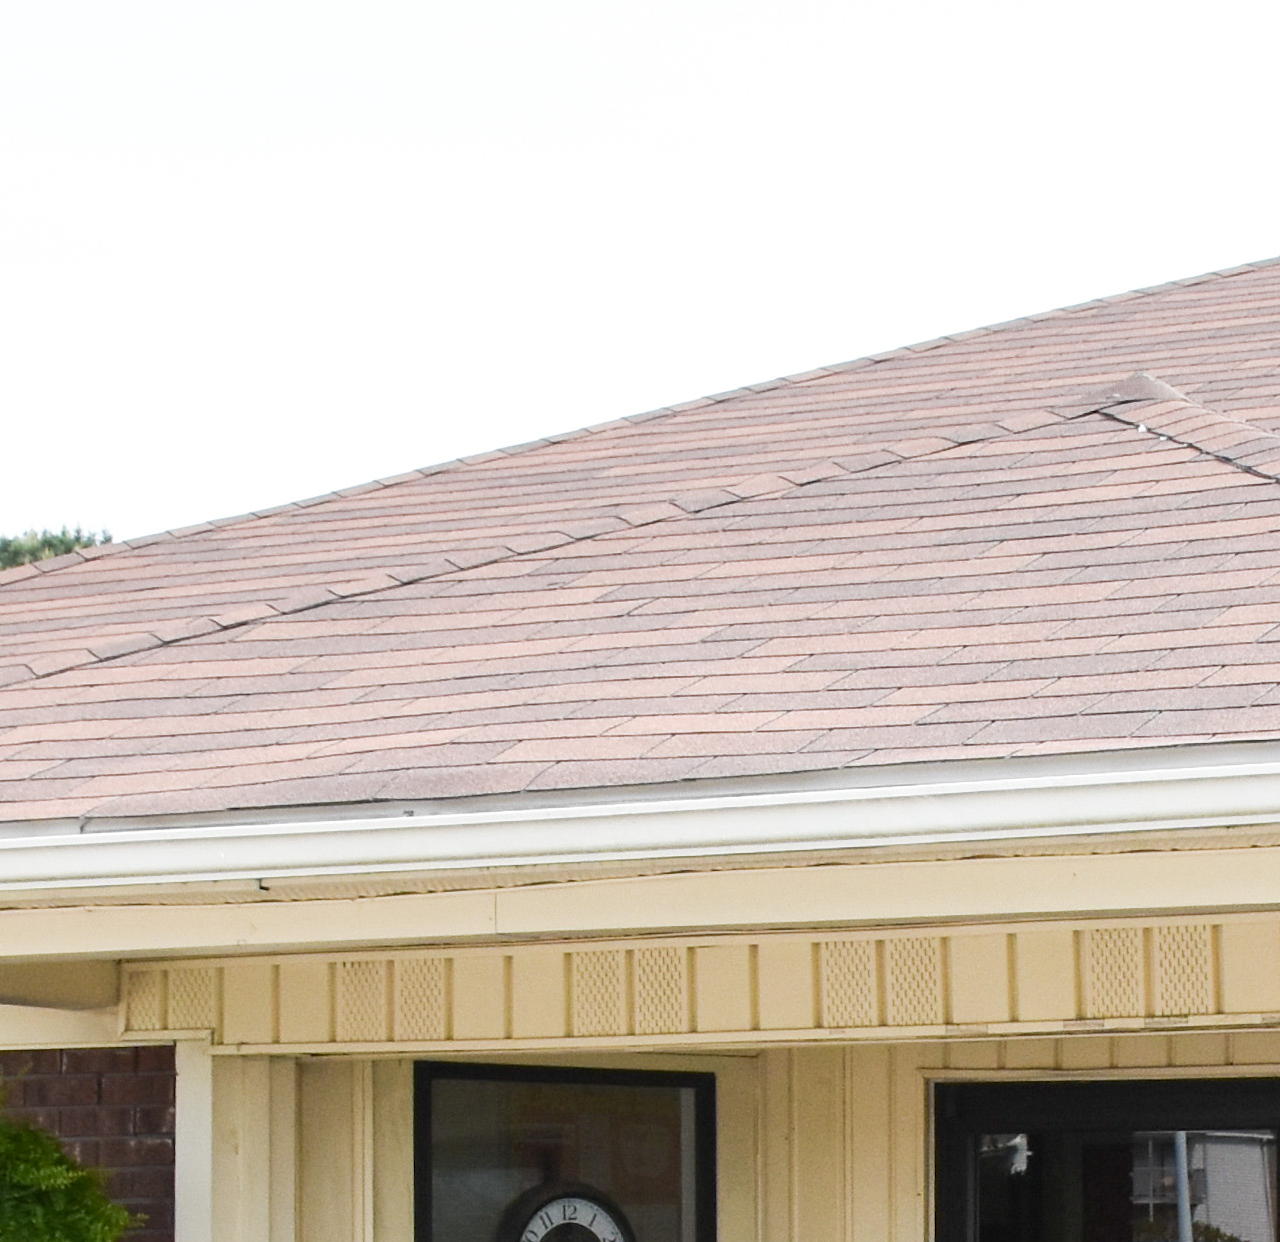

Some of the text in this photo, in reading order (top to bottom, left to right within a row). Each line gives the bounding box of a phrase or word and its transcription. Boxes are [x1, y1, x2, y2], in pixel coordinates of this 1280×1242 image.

[539, 1211, 554, 1230] 11
[561, 1204, 578, 1221] 12
[588, 1213, 597, 1228] 1
